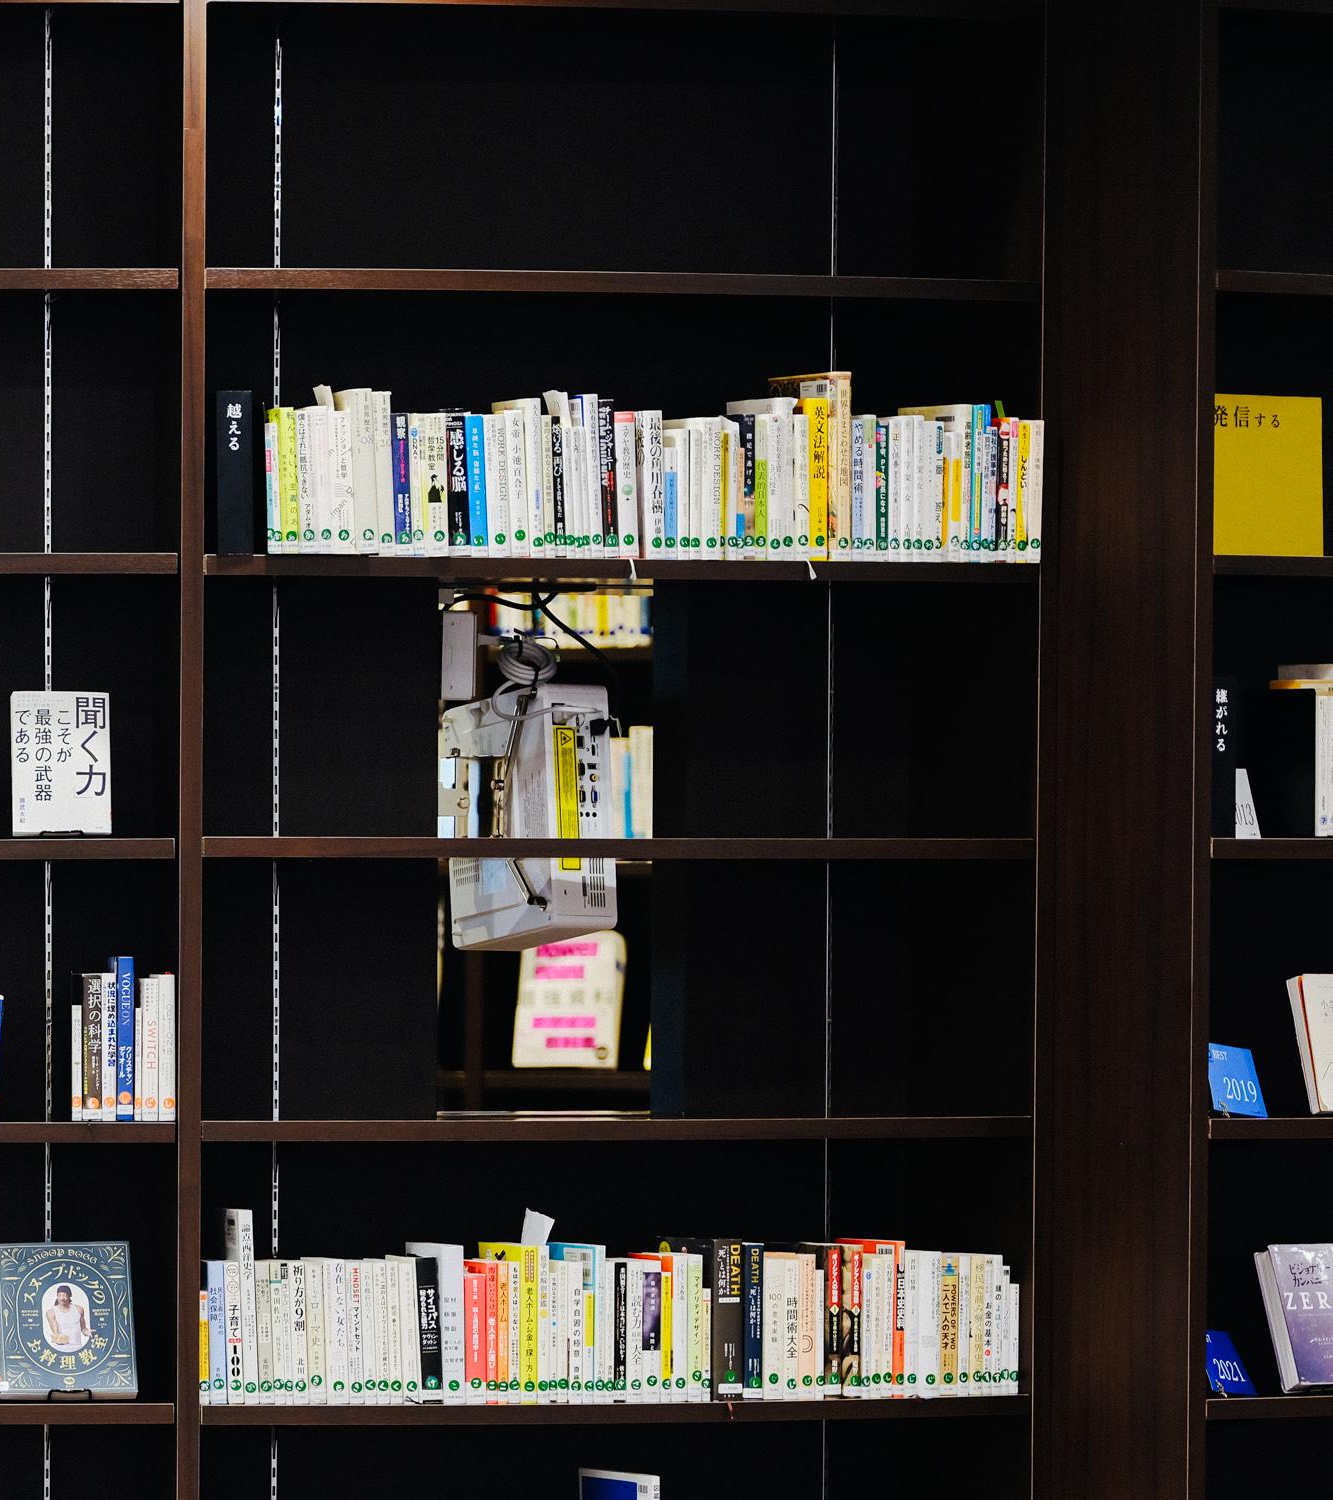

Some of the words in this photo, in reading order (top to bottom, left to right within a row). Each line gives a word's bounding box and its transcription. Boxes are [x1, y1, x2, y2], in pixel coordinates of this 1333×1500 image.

[227, 403, 242, 451] 越える
[15, 709, 30, 763] である
[35, 709, 52, 801] 最強の武器
[57, 709, 73, 762] こそが
[75, 696, 106, 797] 聞く力
[88, 979, 102, 1053] 選択の科学
[146, 1020, 156, 1070] SWITCH
[1223, 1076, 1258, 1104] 2019
[731, 1244, 741, 1295] DEATH
[1212, 1358, 1247, 1383] 2021
